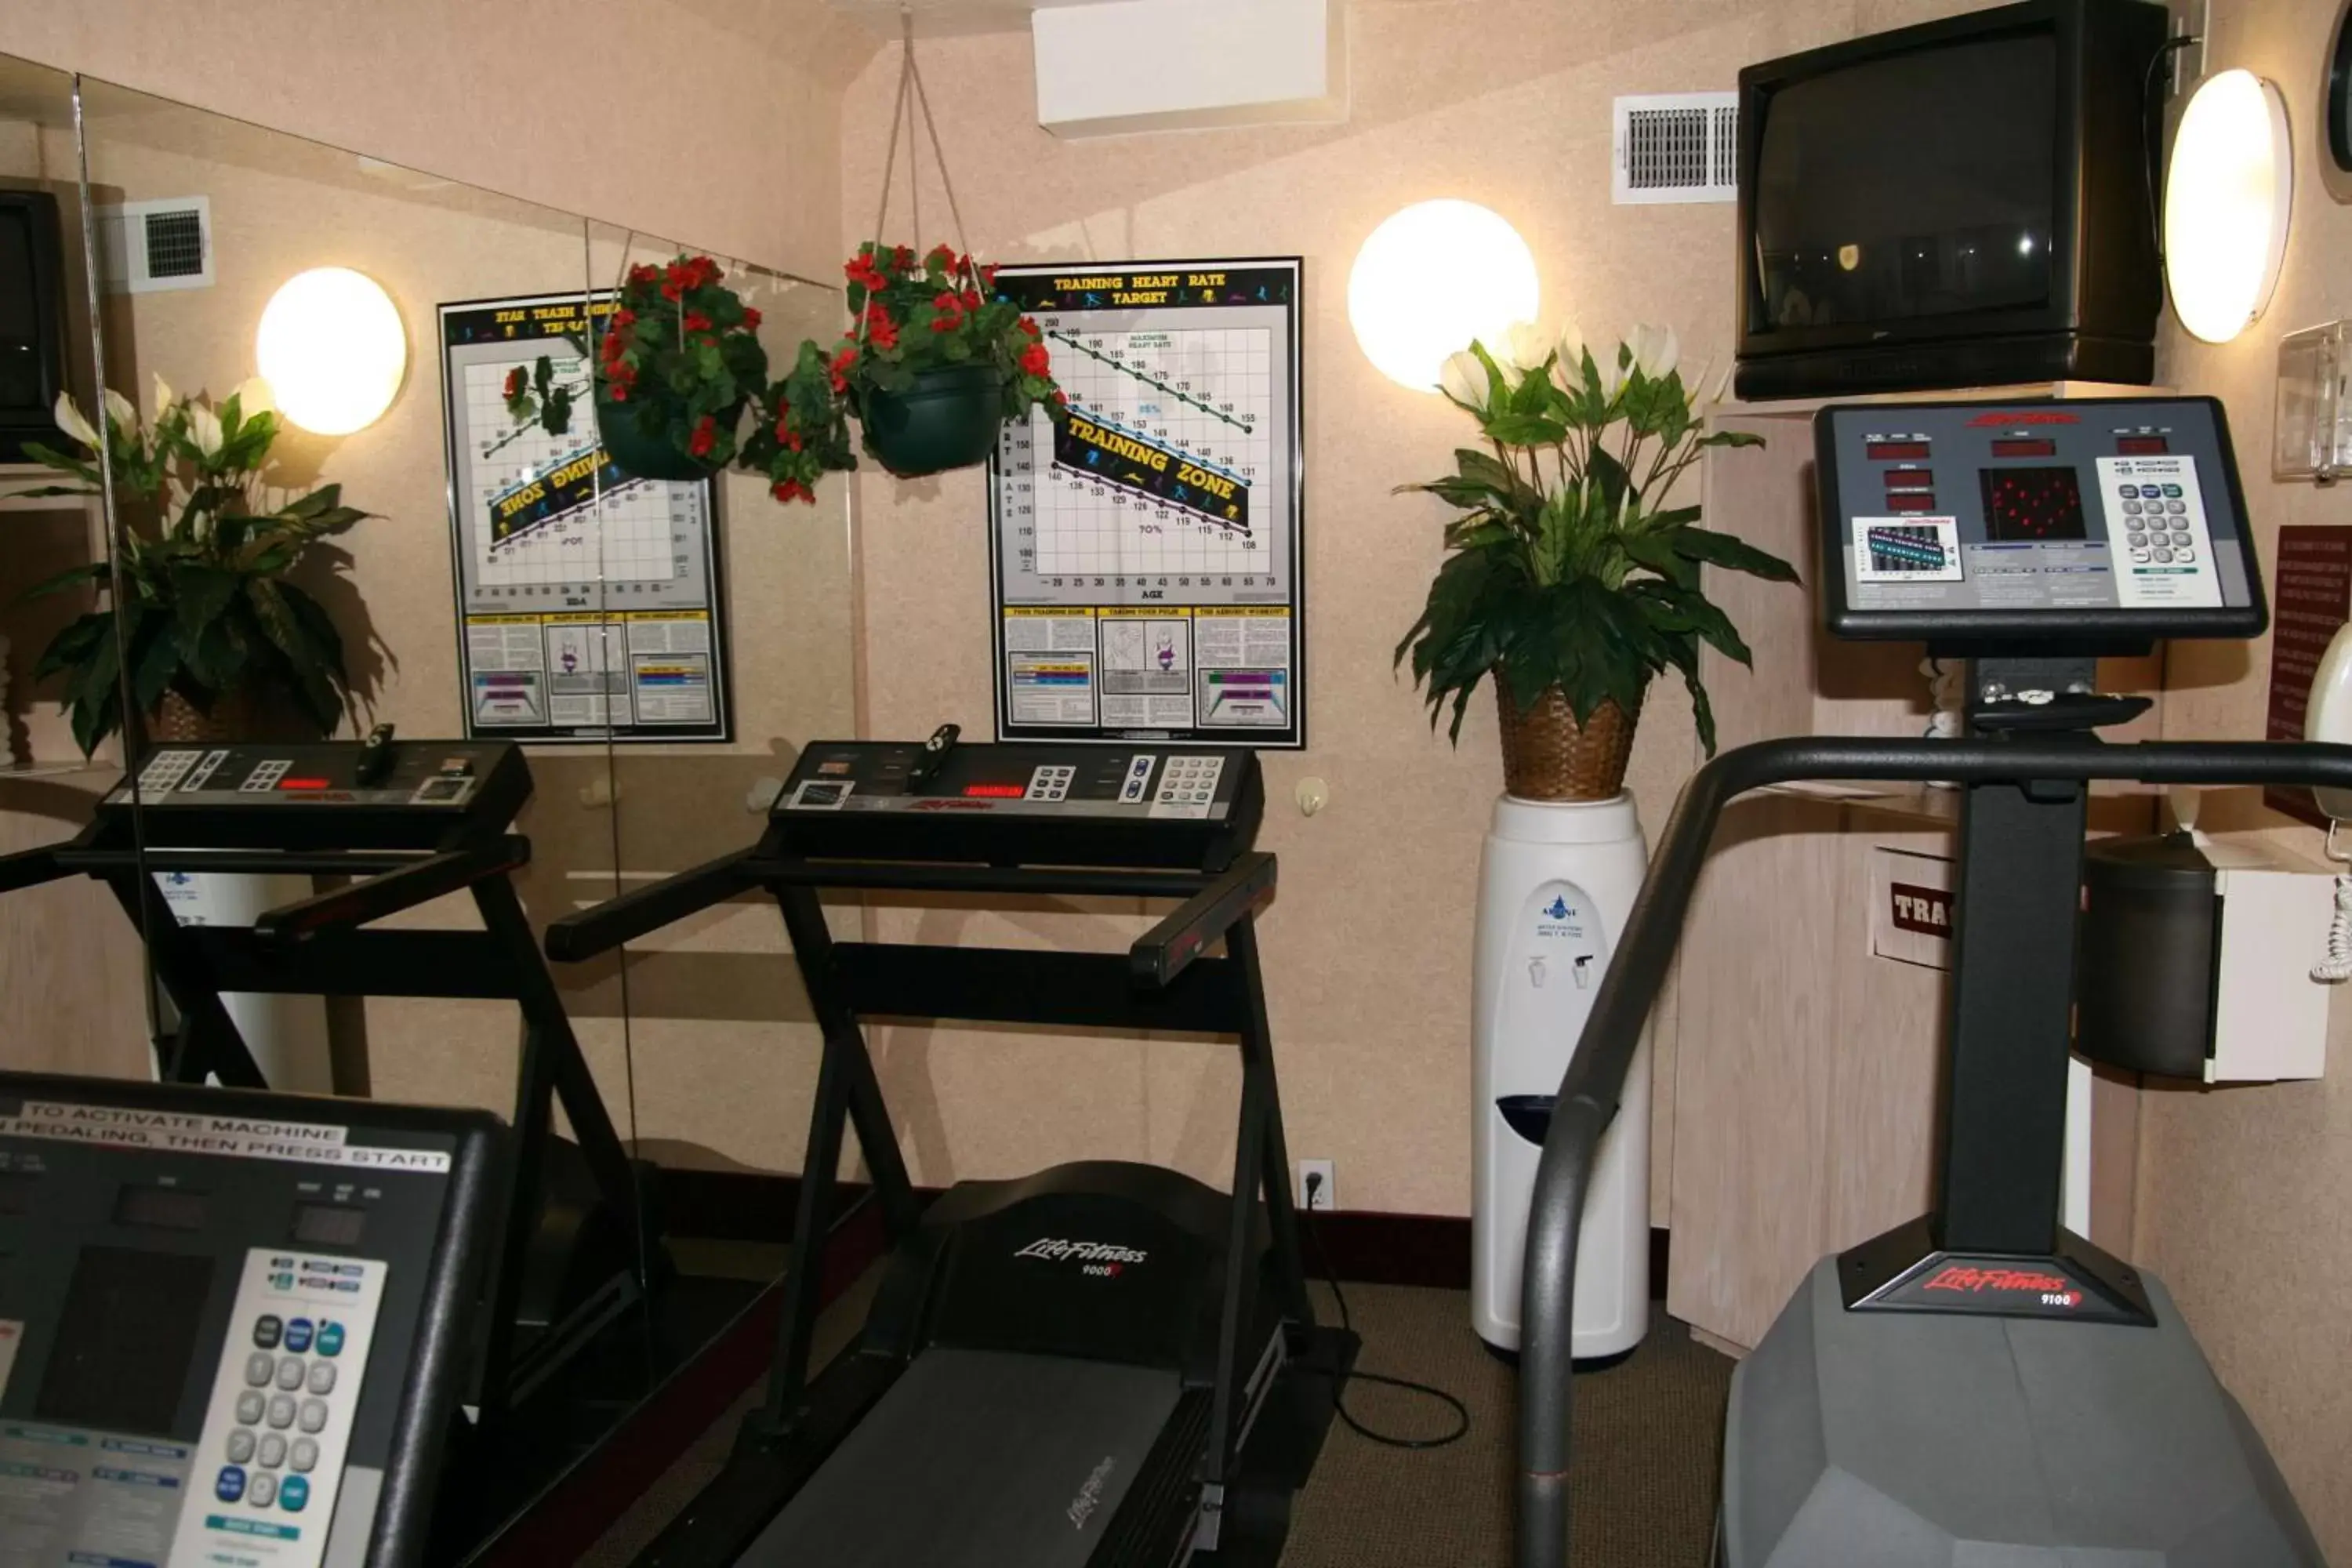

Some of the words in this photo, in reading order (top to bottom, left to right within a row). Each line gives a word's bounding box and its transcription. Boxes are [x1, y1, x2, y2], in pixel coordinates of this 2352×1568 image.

[1054, 277, 1123, 290] TRAINING
[1132, 276, 1178, 288] HEART
[1188, 274, 1225, 286] RATE
[1112, 292, 1167, 304] TARGET
[1069, 417, 1169, 470] TRAINING
[1177, 463, 1236, 499] ZONE
[1894, 894, 1947, 926] TRA
[30, 1105, 64, 1118] TO
[71, 1107, 203, 1129] ACTIVATE
[210, 1119, 340, 1142] MACHINE
[14, 1121, 154, 1147] PEDALING,
[166, 1135, 238, 1152] THEN
[247, 1142, 343, 1160] PRESS
[352, 1151, 449, 1168] START
[1082, 1265, 1112, 1276] 9000
[2042, 1294, 2071, 1305] 9100
